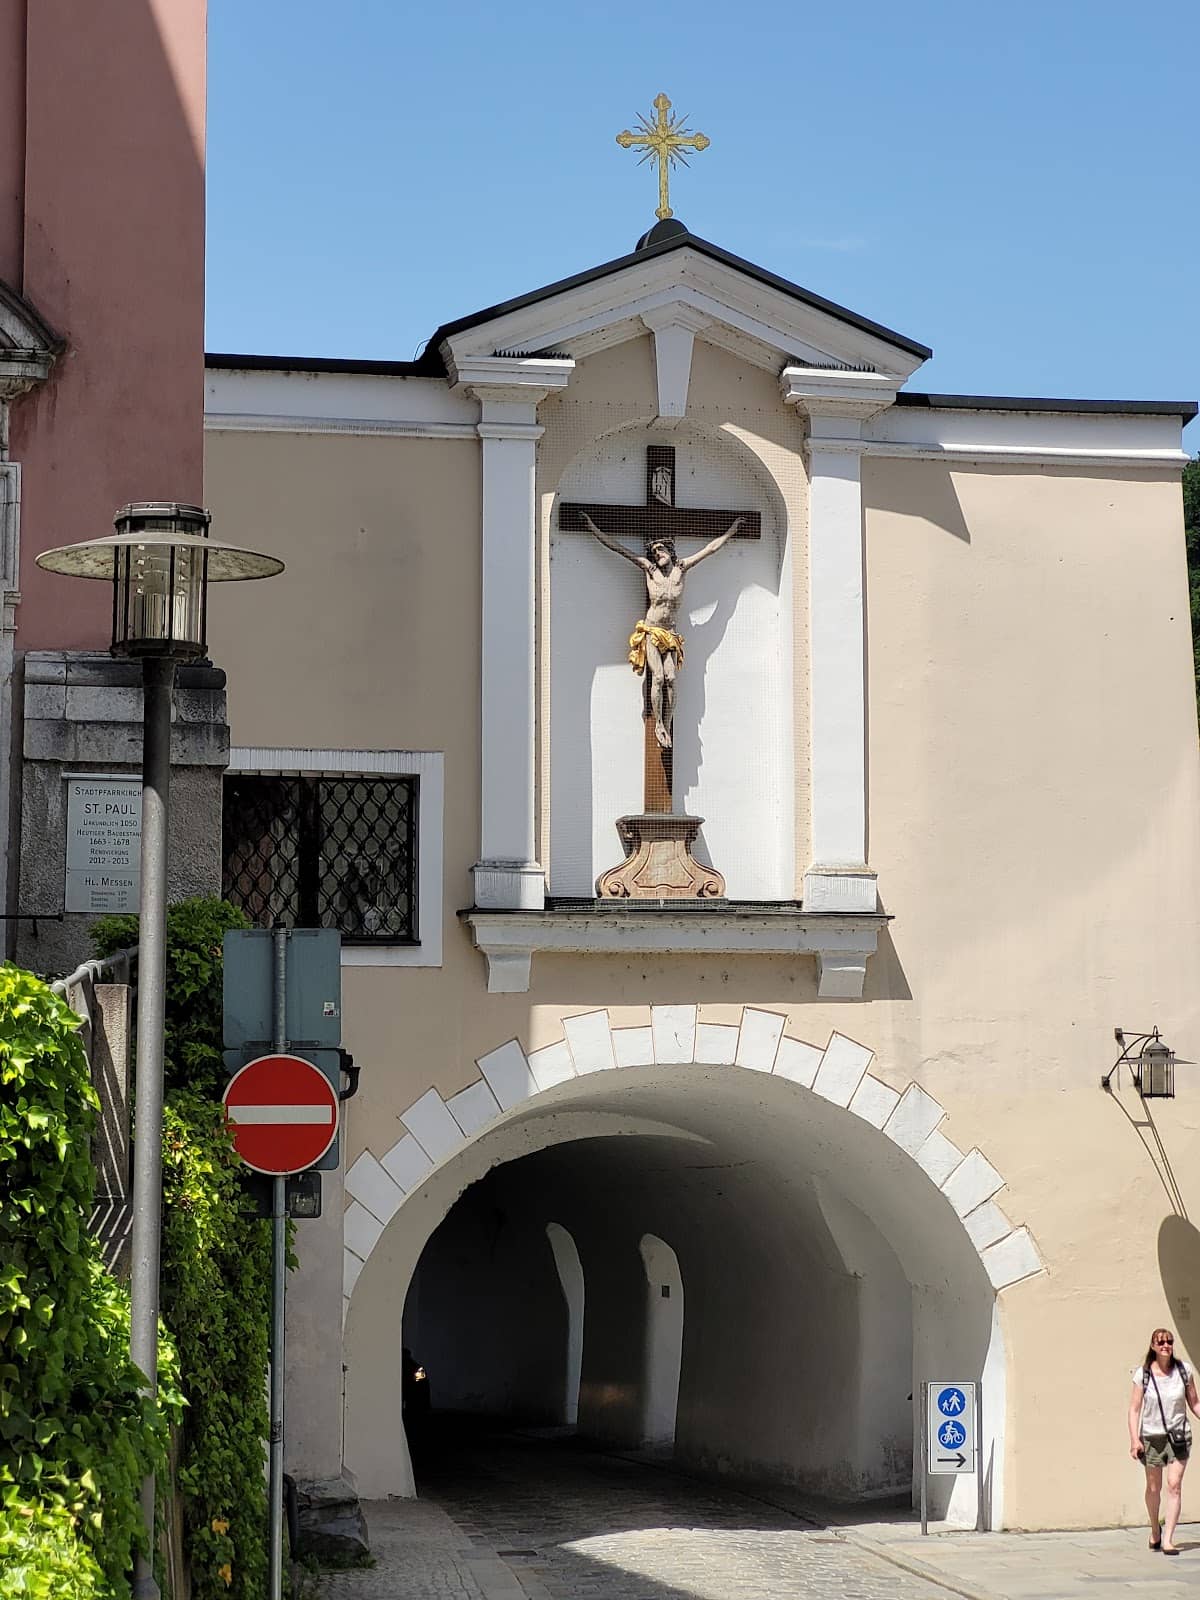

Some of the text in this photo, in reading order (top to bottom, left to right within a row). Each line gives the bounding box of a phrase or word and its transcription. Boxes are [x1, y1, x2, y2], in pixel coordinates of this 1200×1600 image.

[75, 786, 142, 797] STADTPFARRKIRCH
[84, 803, 137, 815] ST. PAUL
[120, 819, 138, 827] 1050
[113, 838, 130, 846] 1678
[88, 856, 106, 864] 2012
[101, 877, 133, 887] MESSEN
